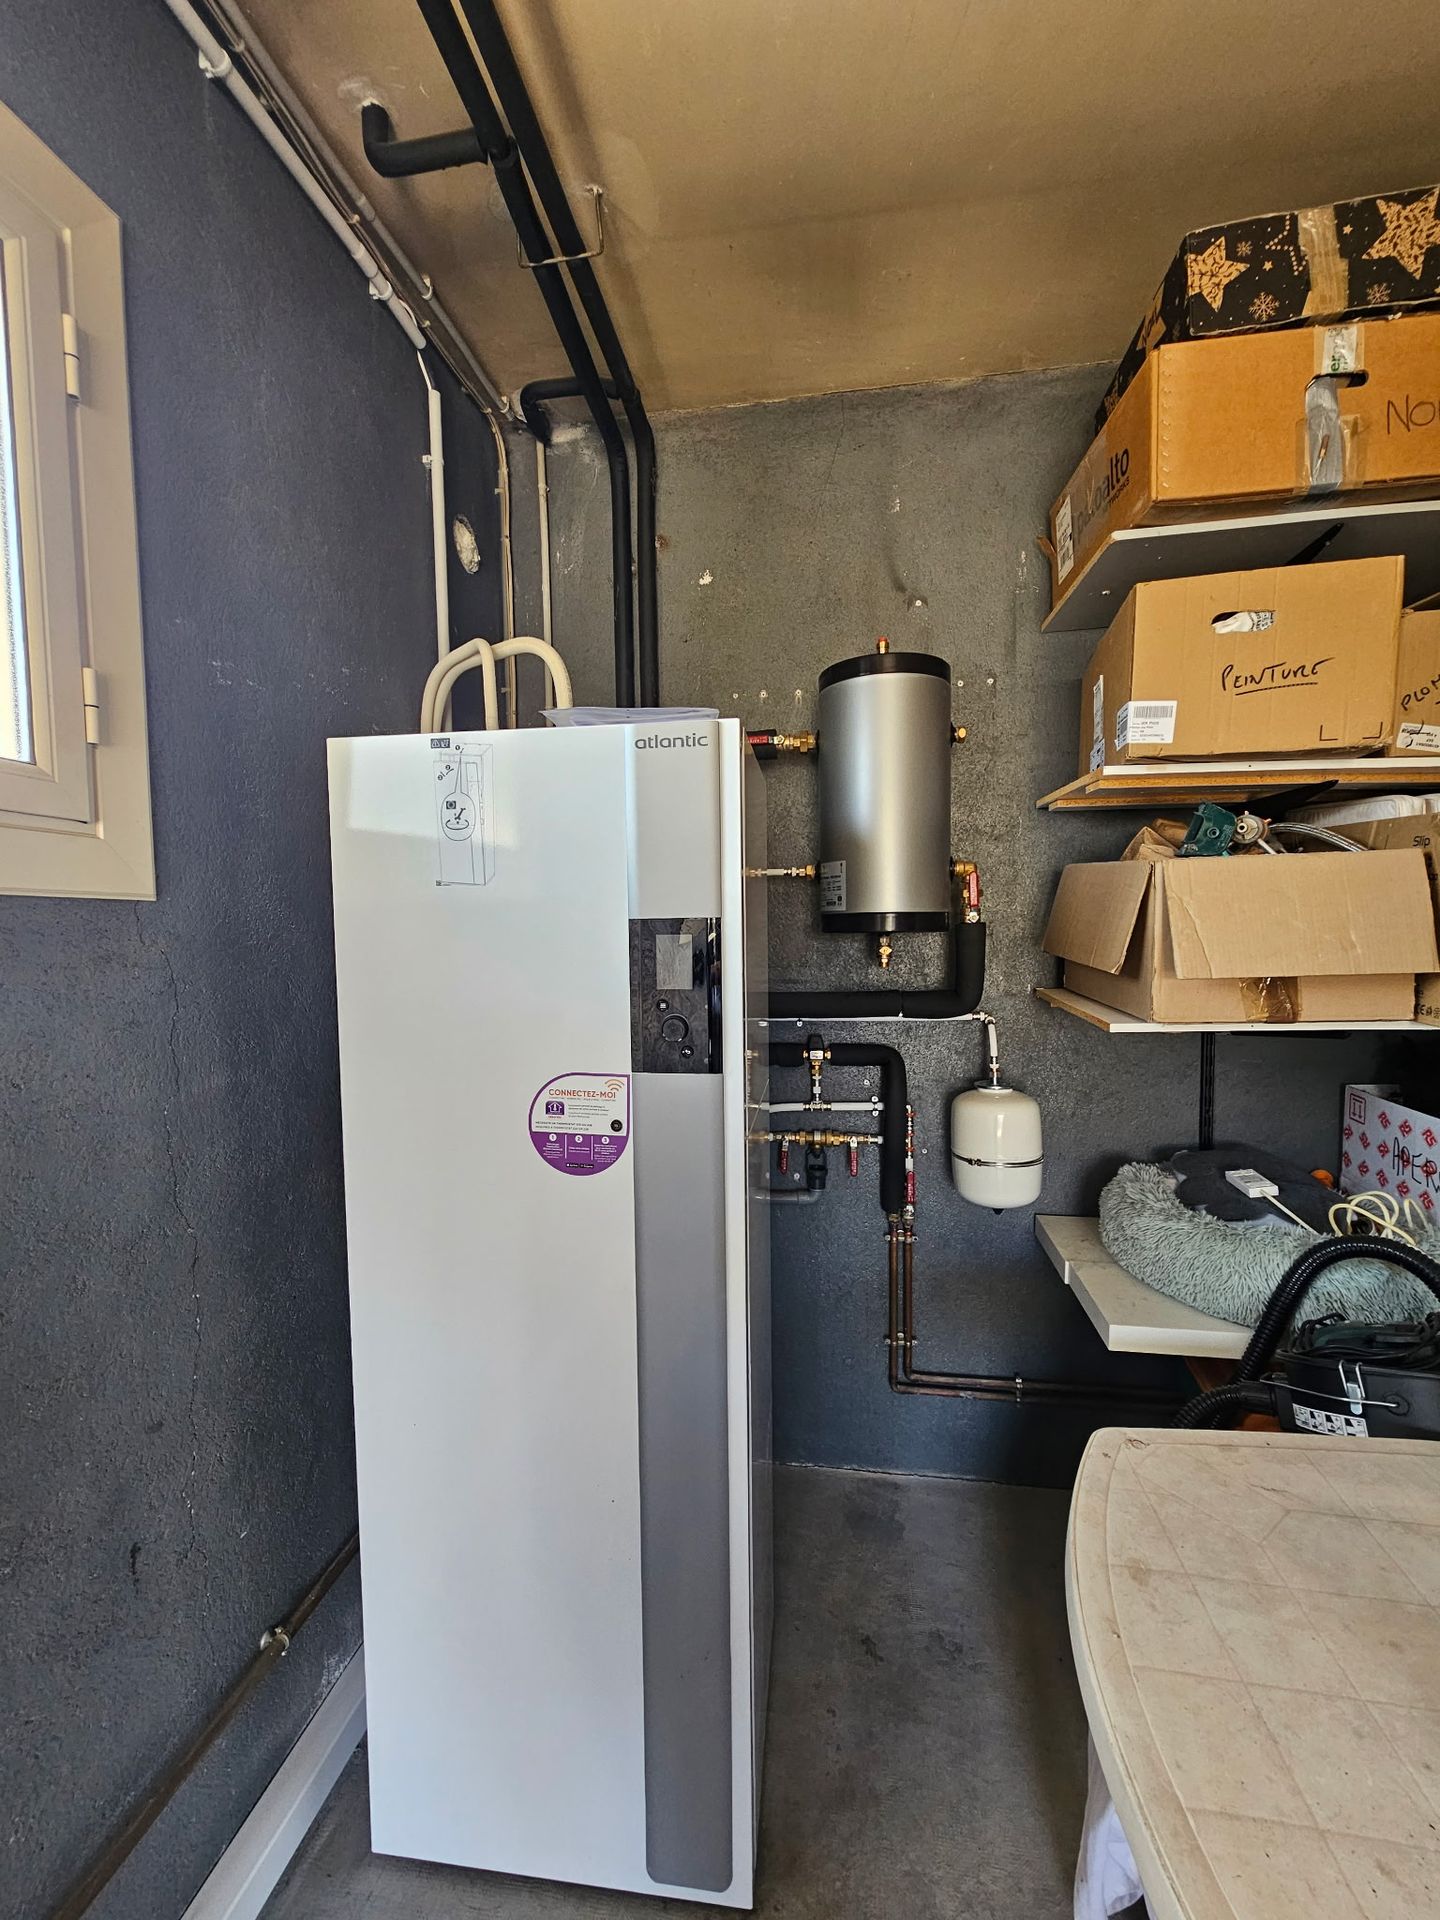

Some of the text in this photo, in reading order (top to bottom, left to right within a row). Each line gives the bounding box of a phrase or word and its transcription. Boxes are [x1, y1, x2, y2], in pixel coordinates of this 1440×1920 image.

[1387, 394, 1440, 435] NO
[1222, 657, 1336, 692] PEINTURE
[634, 732, 709, 750] atlantic
[548, 1088, 617, 1099] CONNECTEZ-MOI
[1392, 1136, 1440, 1193] APER
